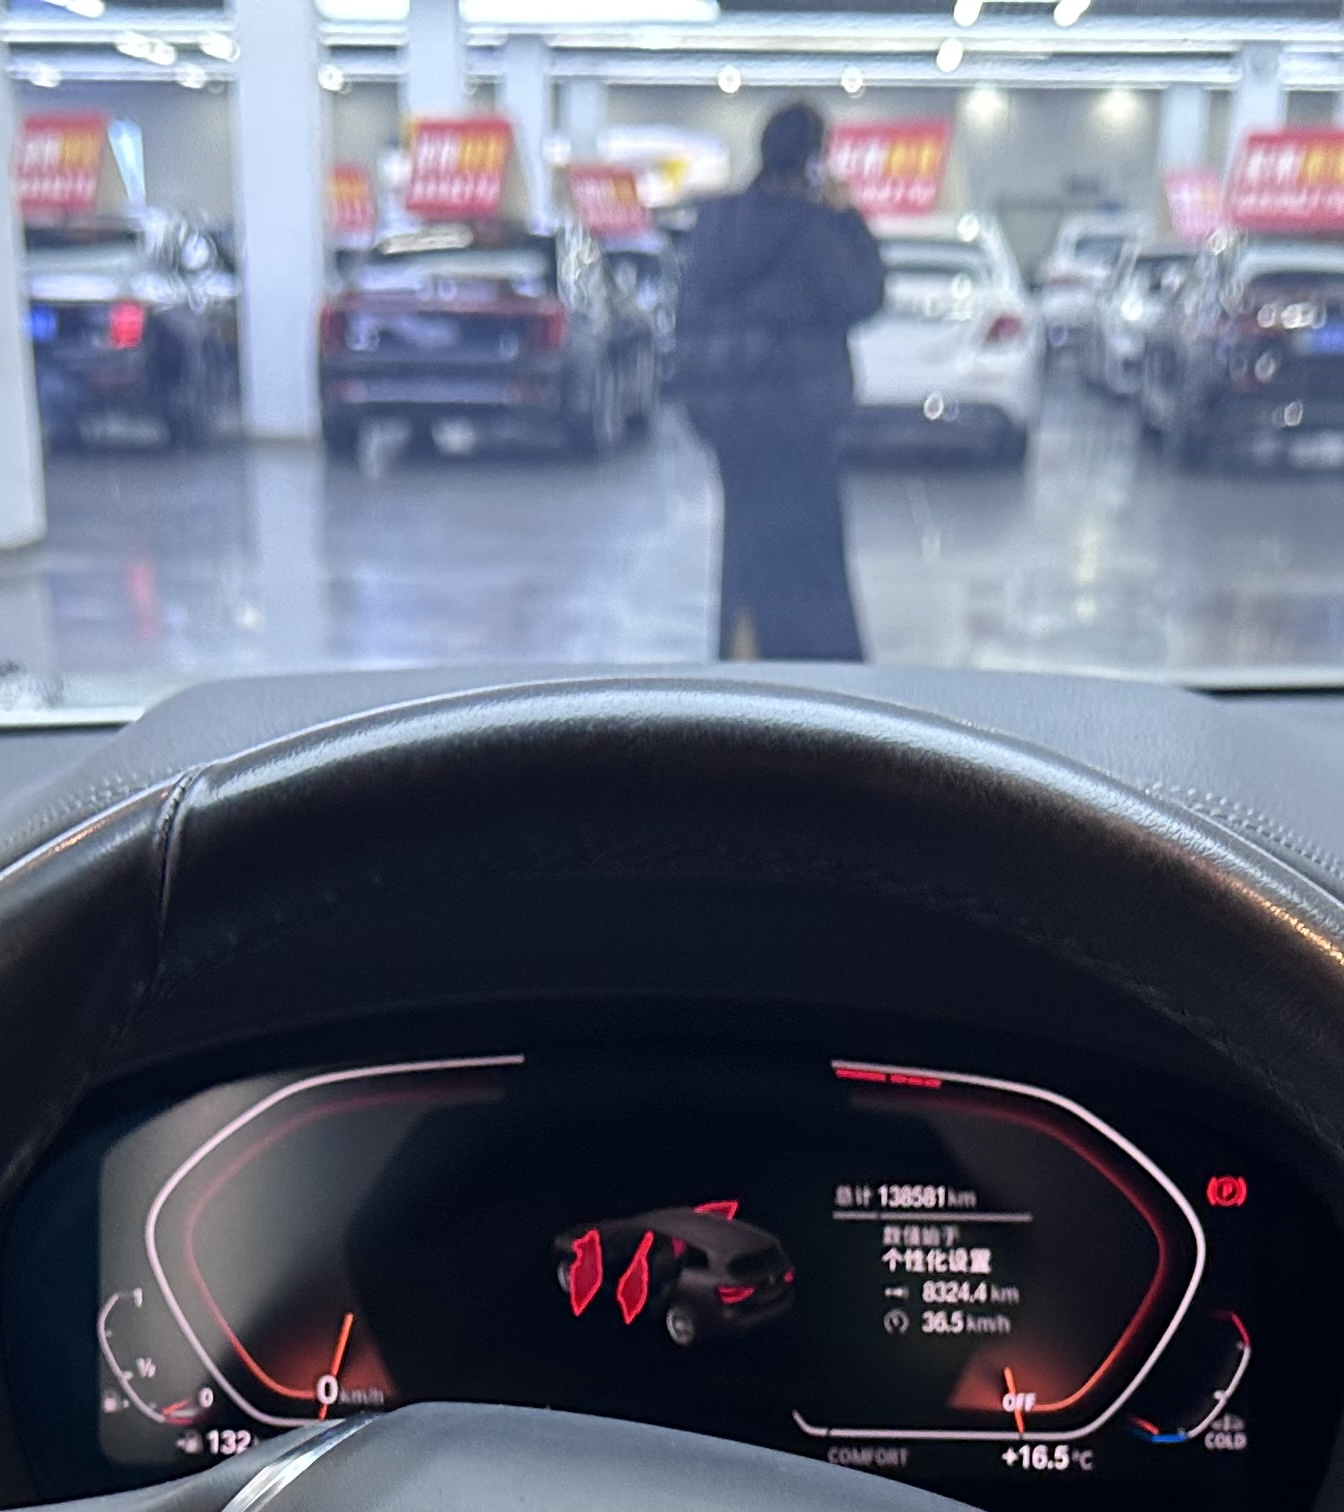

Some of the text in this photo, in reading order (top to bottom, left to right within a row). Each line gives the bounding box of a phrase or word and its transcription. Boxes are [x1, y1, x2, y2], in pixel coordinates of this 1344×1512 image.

[947, 1190, 978, 1207] km
[882, 1248, 991, 1274] 个性化设置
[922, 1280, 1020, 1304] 8324.4 km
[922, 1310, 965, 1334] 36.5
[316, 1373, 339, 1406] 0
[207, 1428, 253, 1455] 132
[1205, 1431, 1247, 1450] COLD
[827, 1444, 909, 1468] COMFORT
[1001, 1444, 1071, 1471] +16.5
